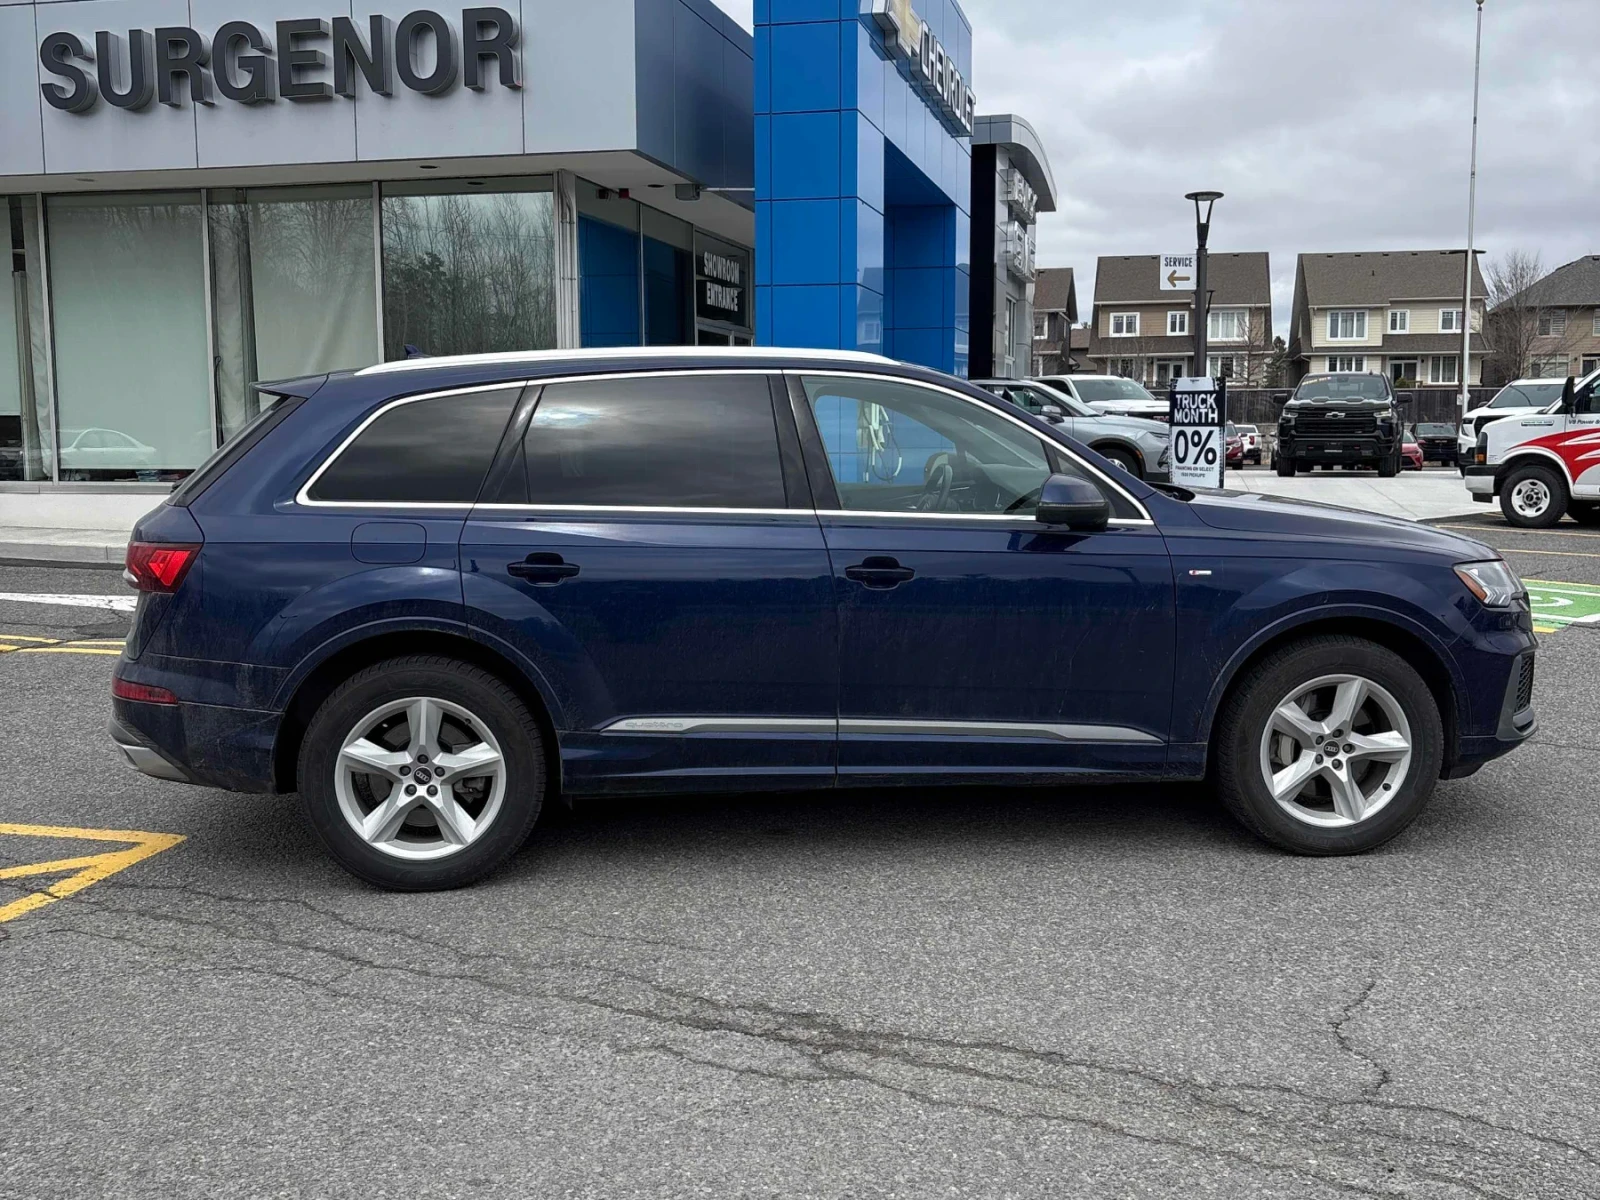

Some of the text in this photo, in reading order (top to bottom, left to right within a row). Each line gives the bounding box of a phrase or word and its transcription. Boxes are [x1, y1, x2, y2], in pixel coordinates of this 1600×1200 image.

[40, 6, 522, 112] SURGENOR
[920, 19, 976, 136] CHEVROLET
[704, 251, 740, 285] SHOWROOM
[1164, 256, 1193, 268] SERVICE
[706, 281, 738, 312] ENTRANCE
[1174, 408, 1218, 424] MONTH
[1175, 393, 1217, 409] TRUCK
[1174, 429, 1217, 466] 0%
